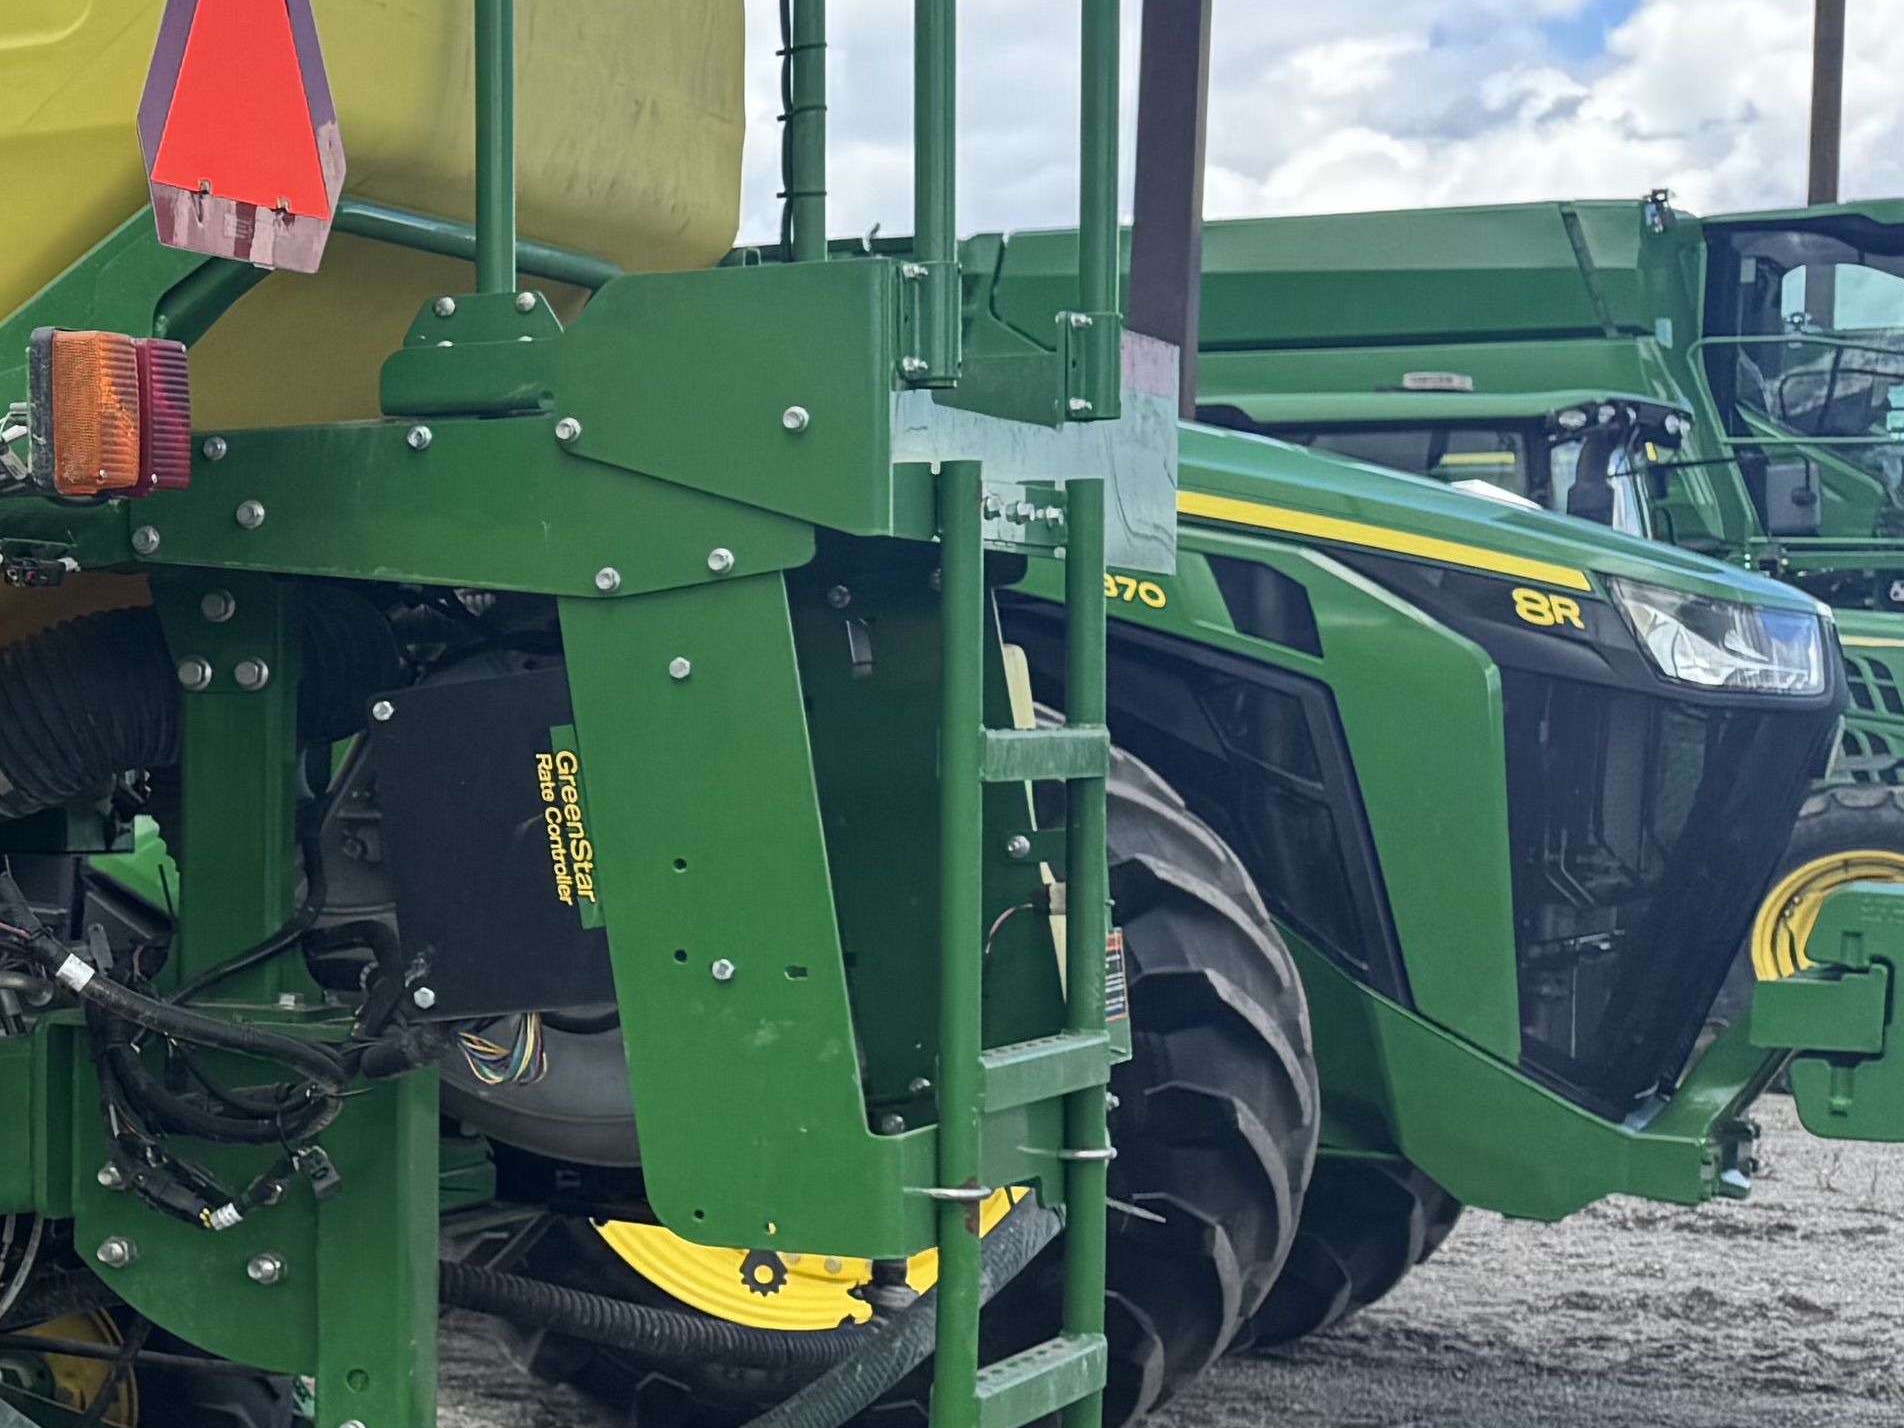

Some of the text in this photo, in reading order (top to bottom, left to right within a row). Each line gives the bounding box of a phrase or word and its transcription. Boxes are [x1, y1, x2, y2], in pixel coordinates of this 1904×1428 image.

[1512, 587, 1585, 629] 8R
[535, 753, 574, 906] Rate Controller
[555, 750, 596, 903] GreenStar
